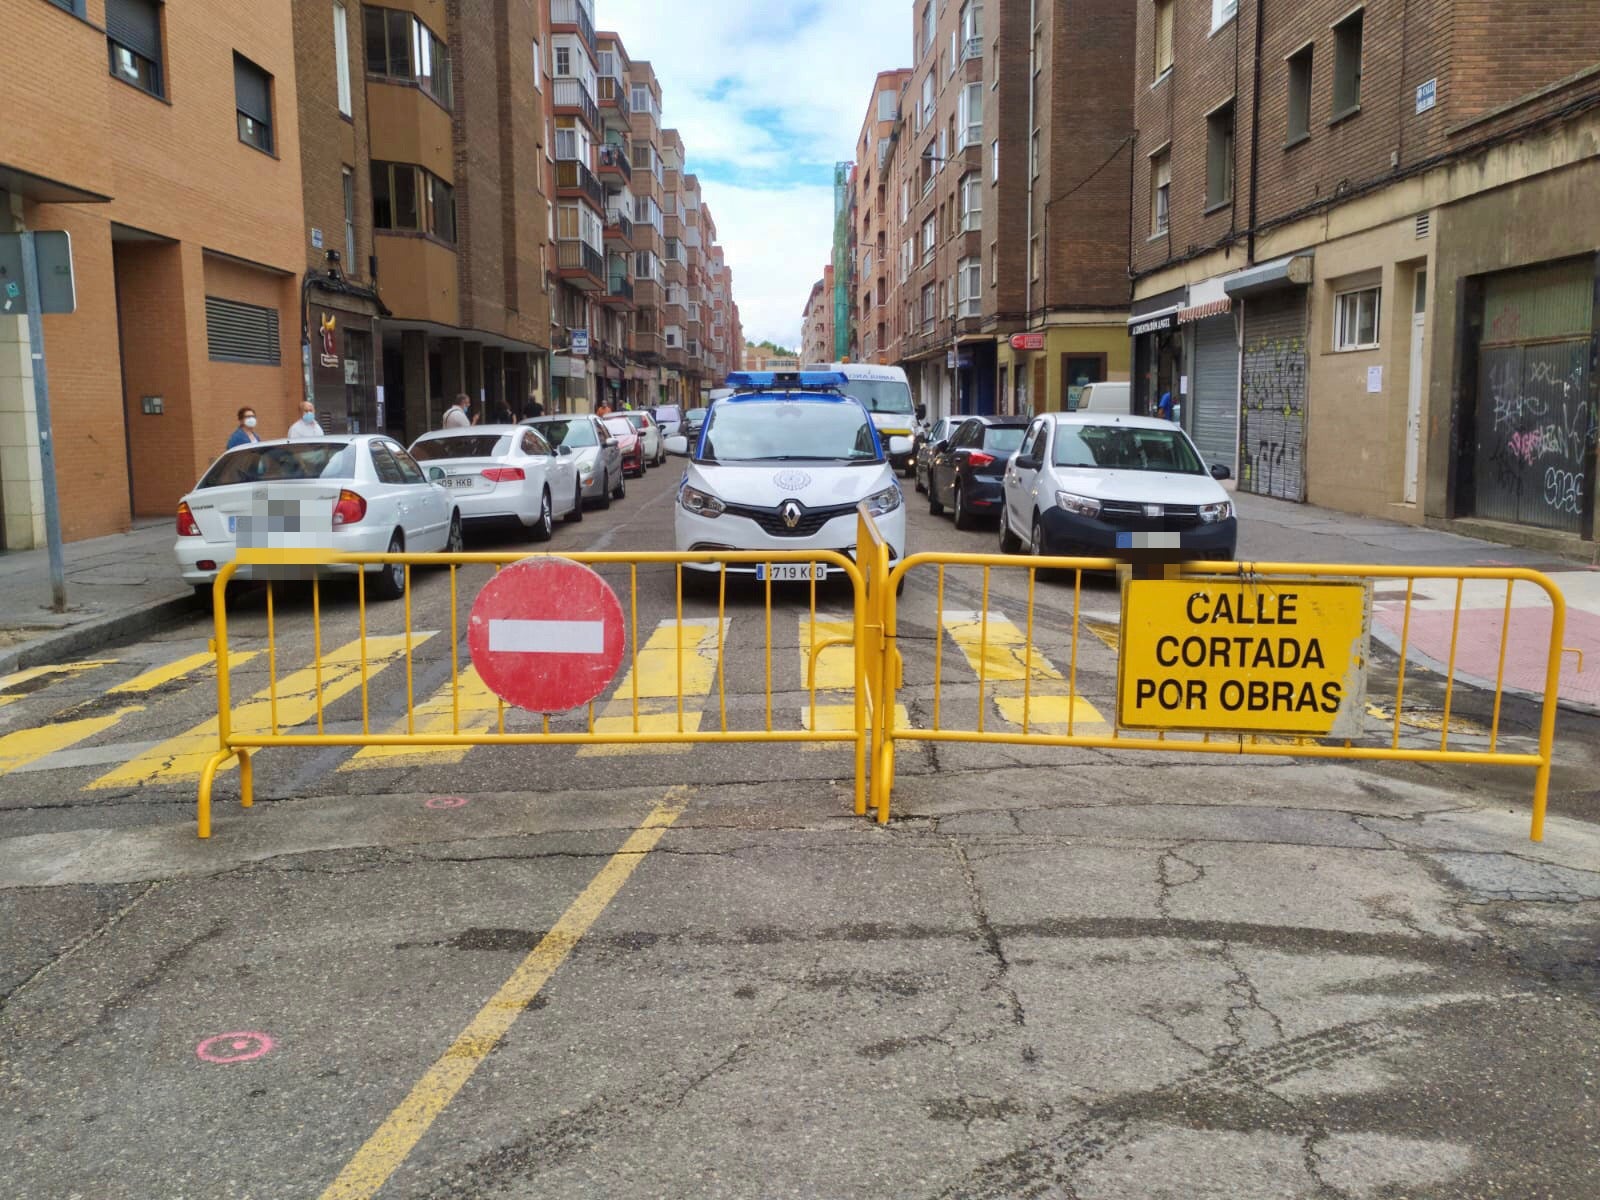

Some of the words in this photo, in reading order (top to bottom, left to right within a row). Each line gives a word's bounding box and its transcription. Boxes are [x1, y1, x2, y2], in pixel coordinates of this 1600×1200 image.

[767, 566, 797, 579] 719
[1186, 592, 1298, 625] CALLE
[1156, 635, 1325, 669] CORTADA
[1136, 679, 1208, 711] POR
[1219, 679, 1342, 713] OBRAS
